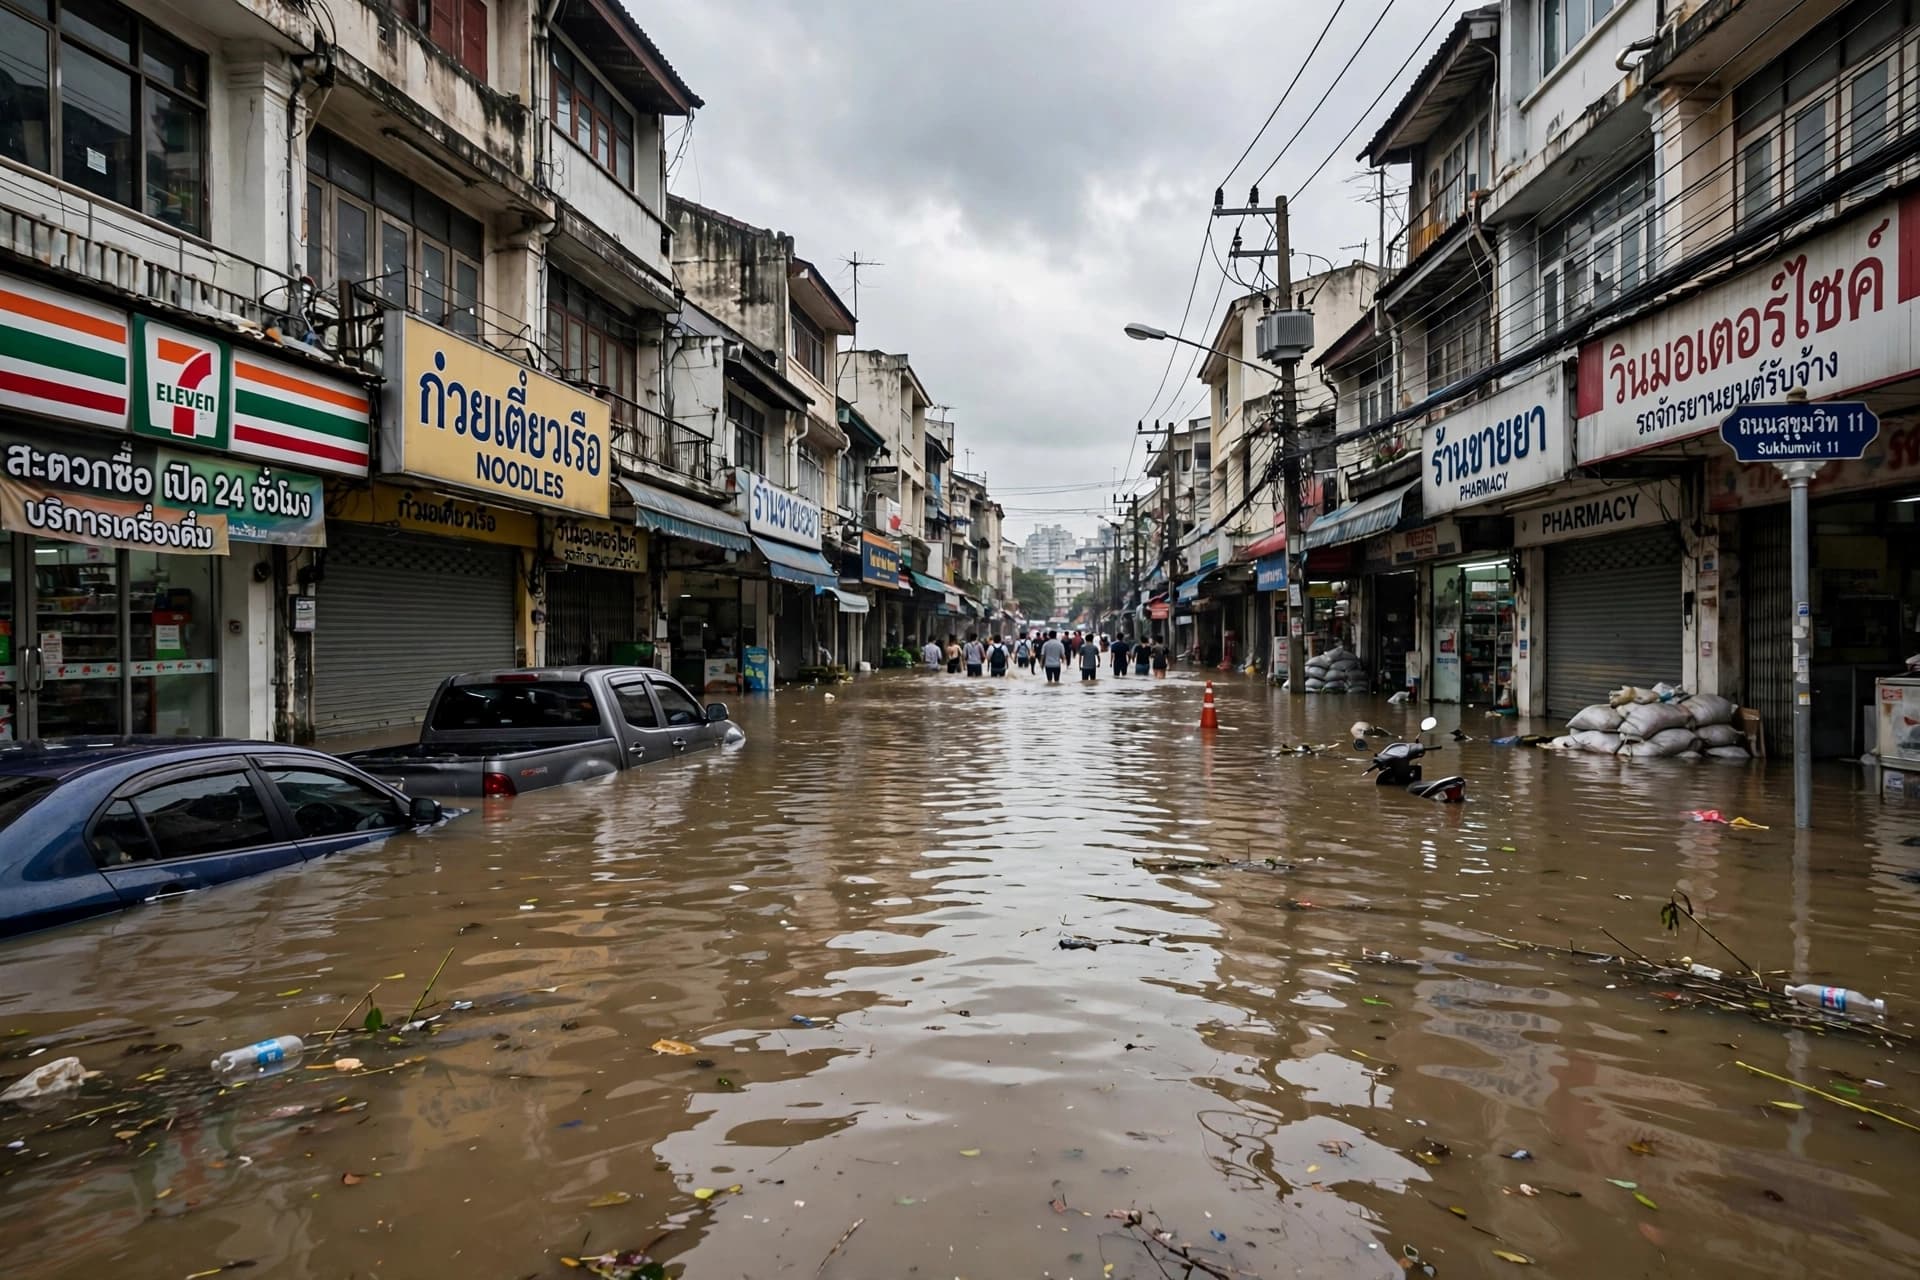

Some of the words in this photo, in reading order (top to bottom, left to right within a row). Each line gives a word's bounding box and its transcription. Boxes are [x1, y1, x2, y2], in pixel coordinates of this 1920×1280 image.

[1609, 218, 1890, 404] วินมอเตอร์ไซค์
[157, 337, 212, 436] 7
[1636, 344, 1838, 435] รถจักรยานยนต์รับจ้าง
[1432, 405, 1546, 487] ร้านขายยา
[1739, 409, 1838, 441] ถนนสุขุมวิท
[1848, 412, 1864, 432] 11
[1757, 441, 1821, 455] Sukhumvit
[1827, 441, 1839, 453] 11
[163, 463, 208, 504] เปิด
[215, 474, 245, 508] 24
[476, 453, 564, 499] NOODLES
[1460, 472, 1508, 501] PHARMACY
[26, 498, 212, 548] บริการเครื่องดื่ม
[1542, 493, 1640, 535] PHARMACY
